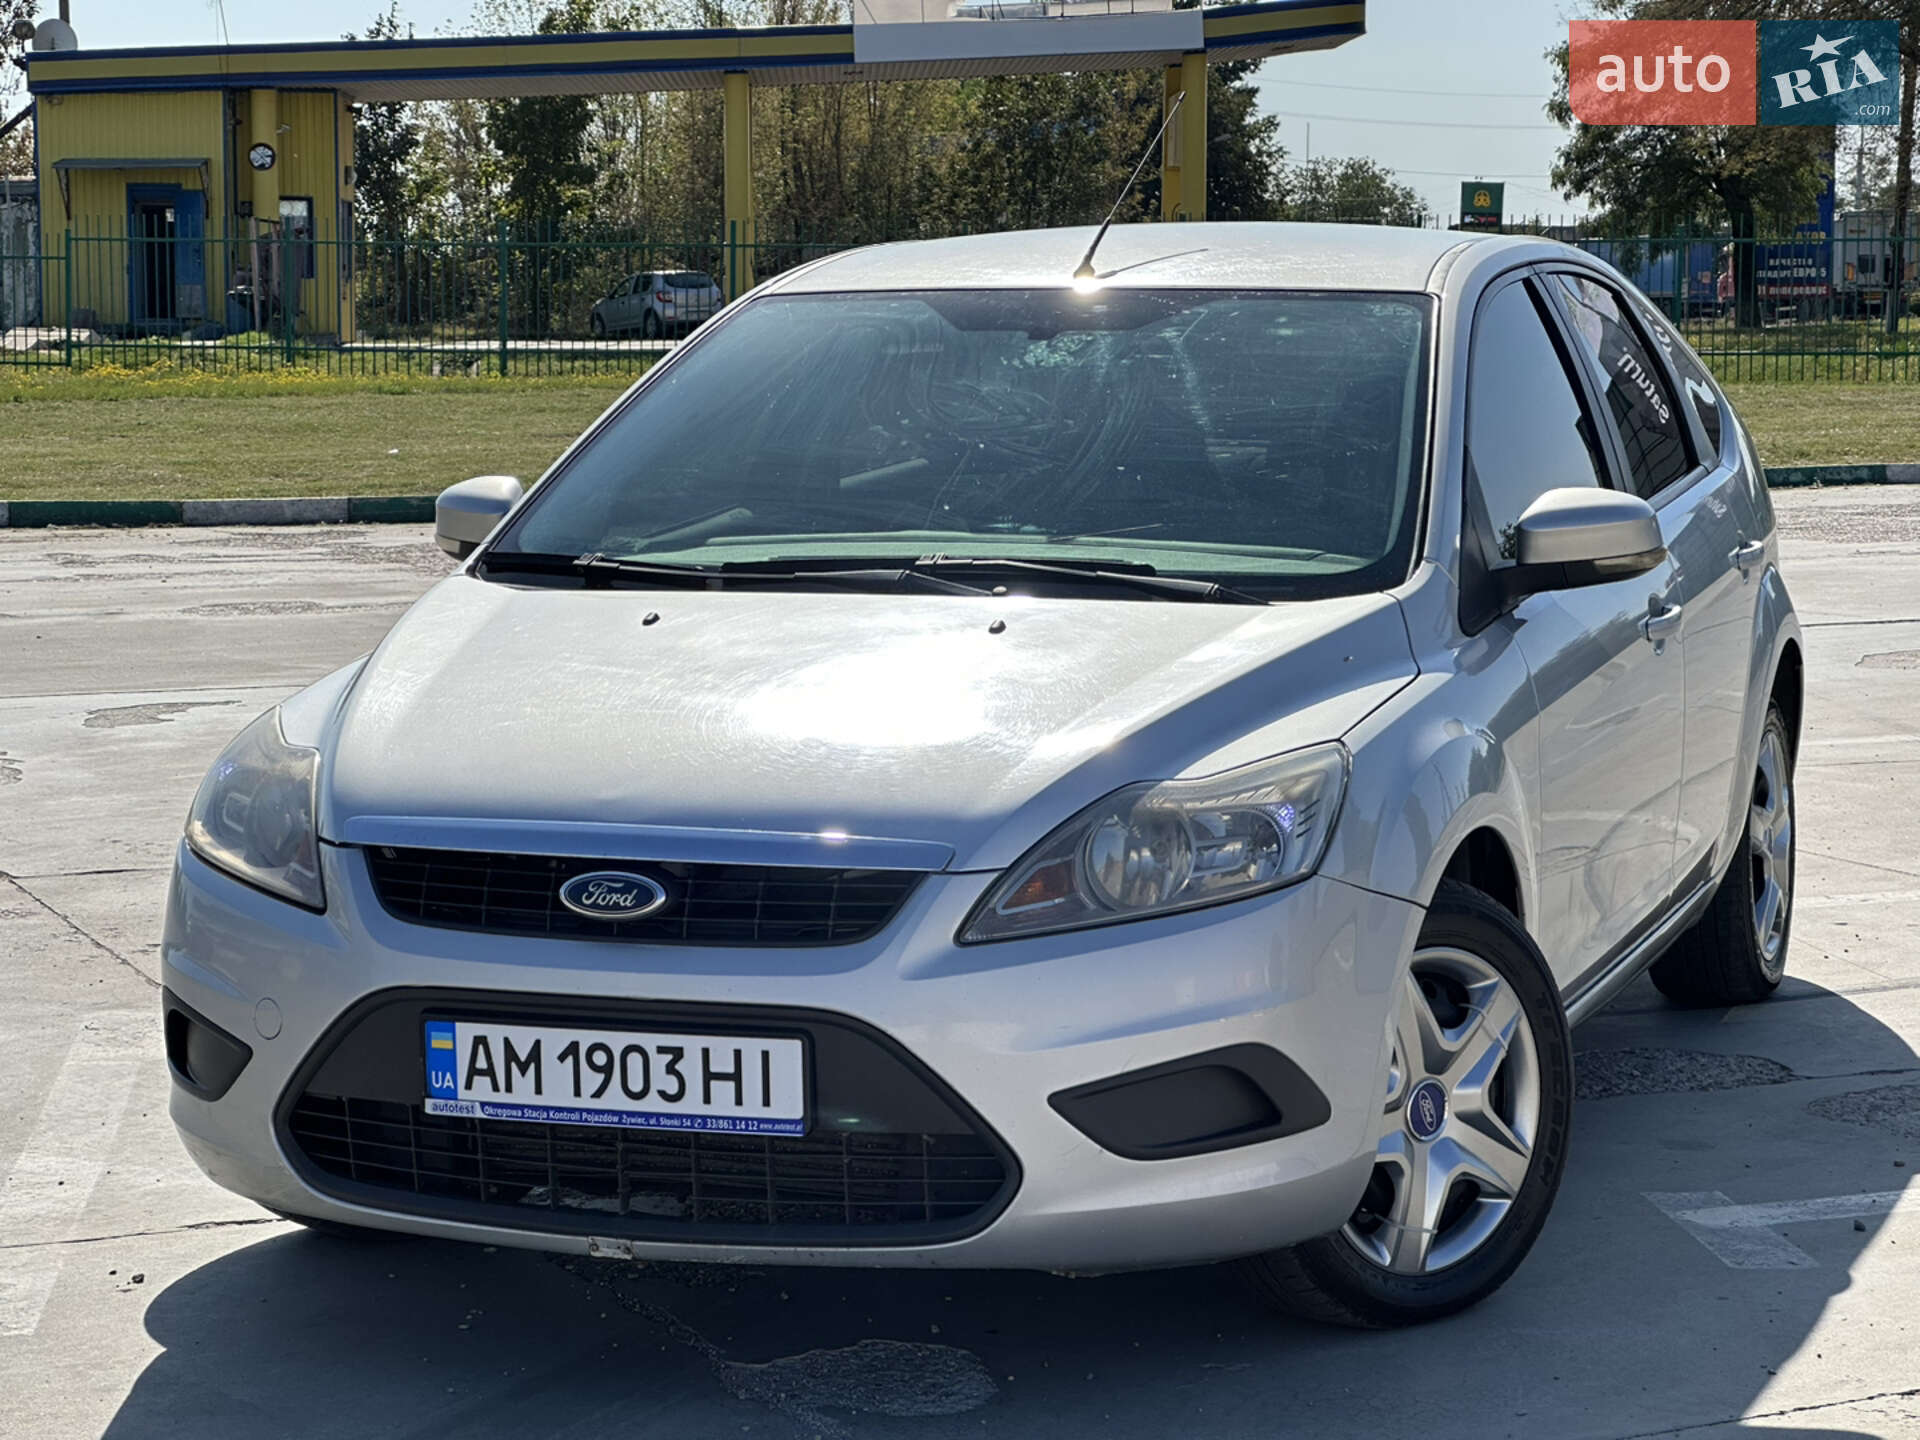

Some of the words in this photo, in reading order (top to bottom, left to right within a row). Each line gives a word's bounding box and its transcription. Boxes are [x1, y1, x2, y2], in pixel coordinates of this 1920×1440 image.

[582, 880, 638, 907] Ford
[431, 1071, 454, 1089] UA
[464, 1035, 542, 1095] AM
[557, 1040, 686, 1103] 1903
[702, 1047, 771, 1107] HI
[431, 1102, 475, 1115] autotest
[524, 1106, 547, 1120] Stacja
[549, 1108, 580, 1121] Kontroli
[736, 1120, 746, 1130] 14
[747, 1121, 758, 1131] 12
